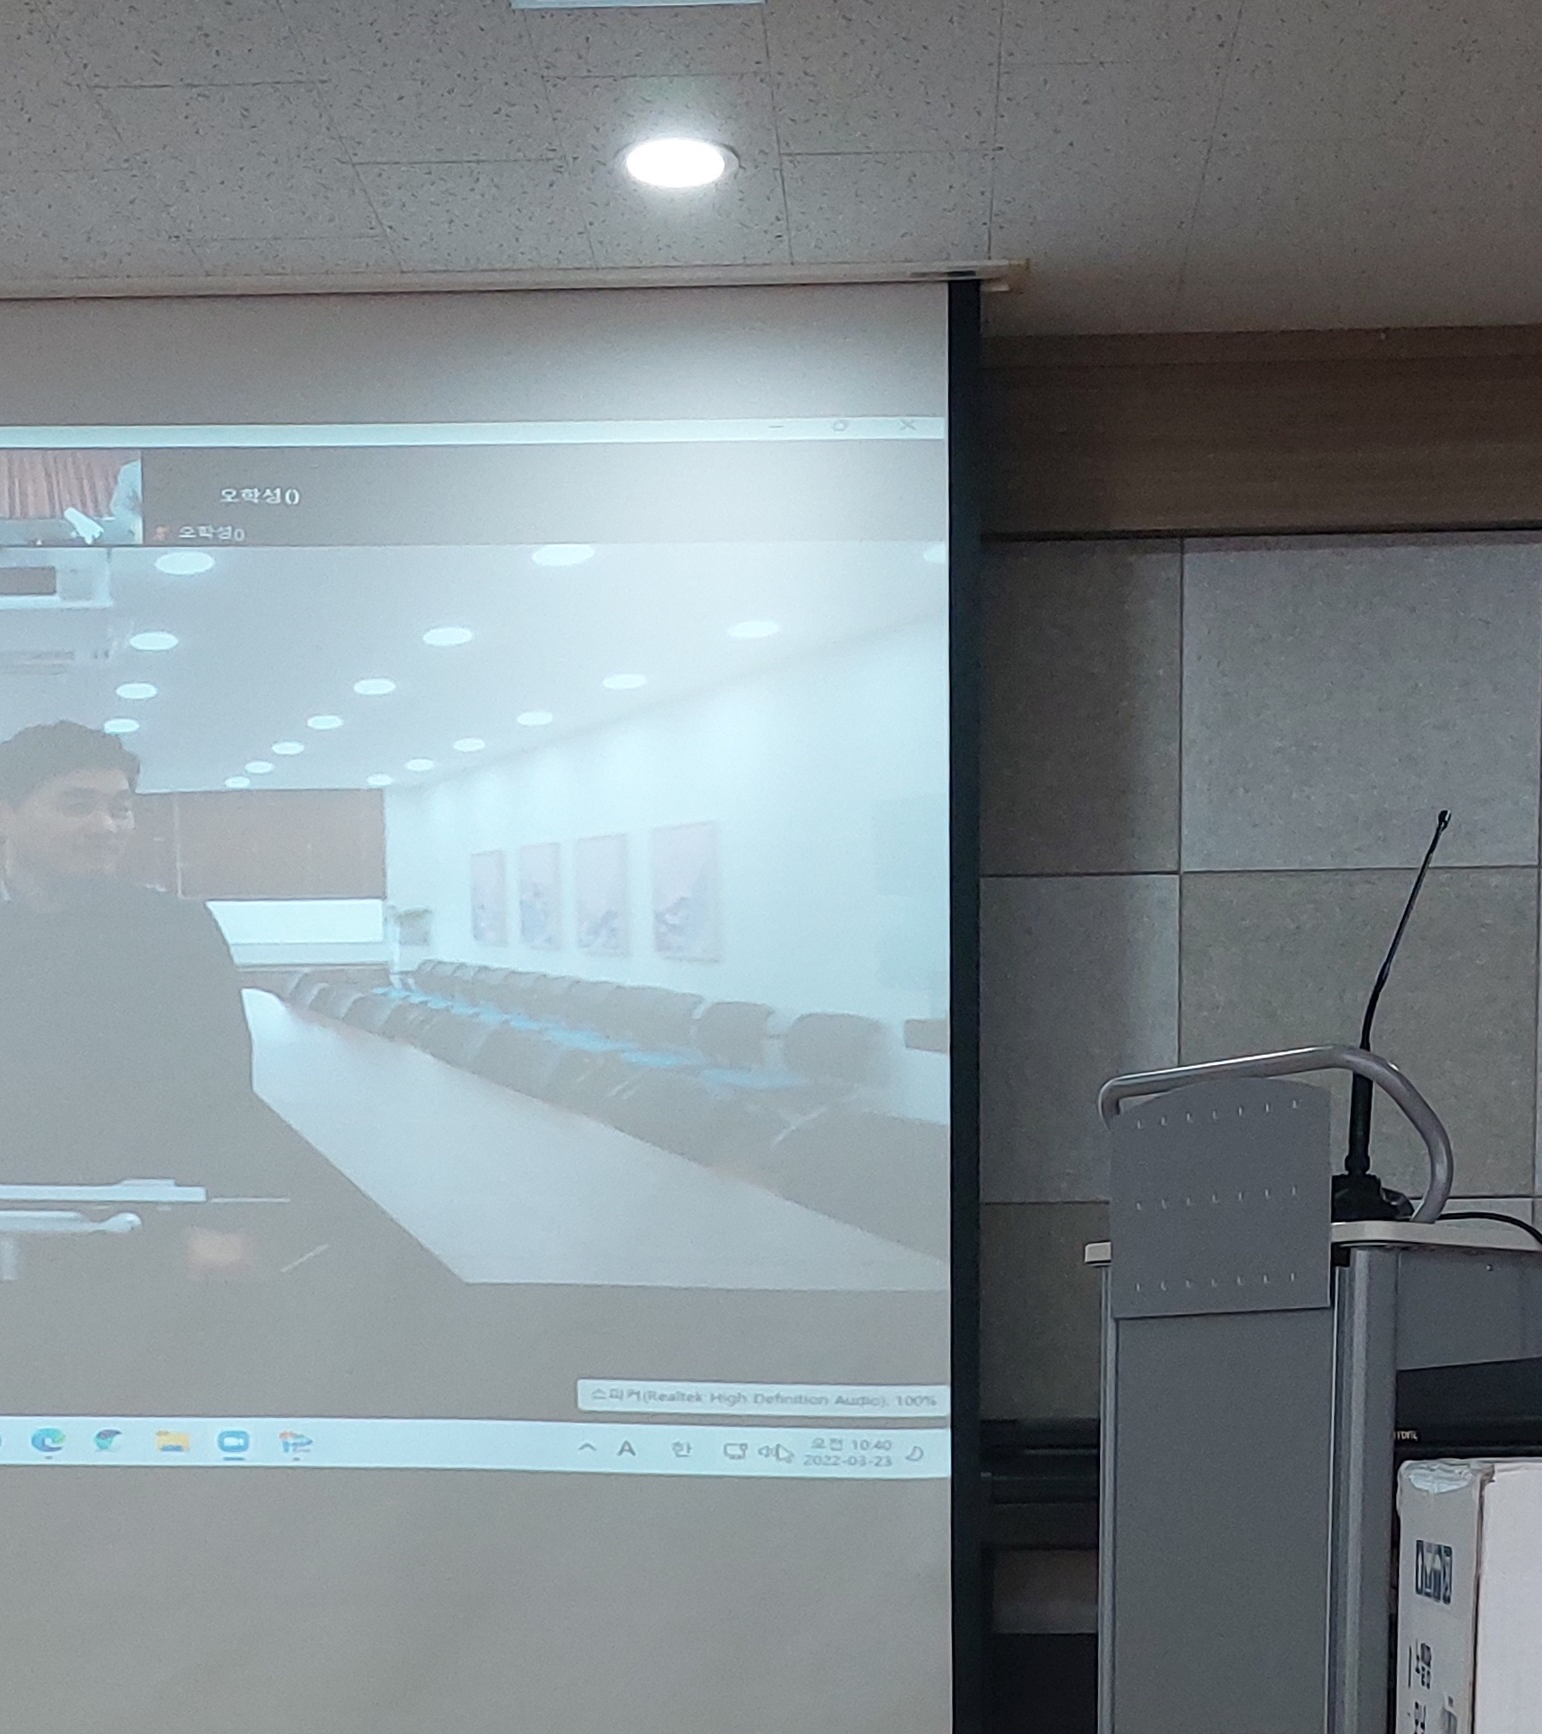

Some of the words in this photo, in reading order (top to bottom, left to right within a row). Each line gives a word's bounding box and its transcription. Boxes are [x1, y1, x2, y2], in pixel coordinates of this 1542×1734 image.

[219, 487, 301, 505] 오학성()
[710, 1390, 748, 1407] High
[754, 1392, 829, 1406] Definition
[896, 1395, 939, 1408] 100%
[617, 1440, 637, 1457] A
